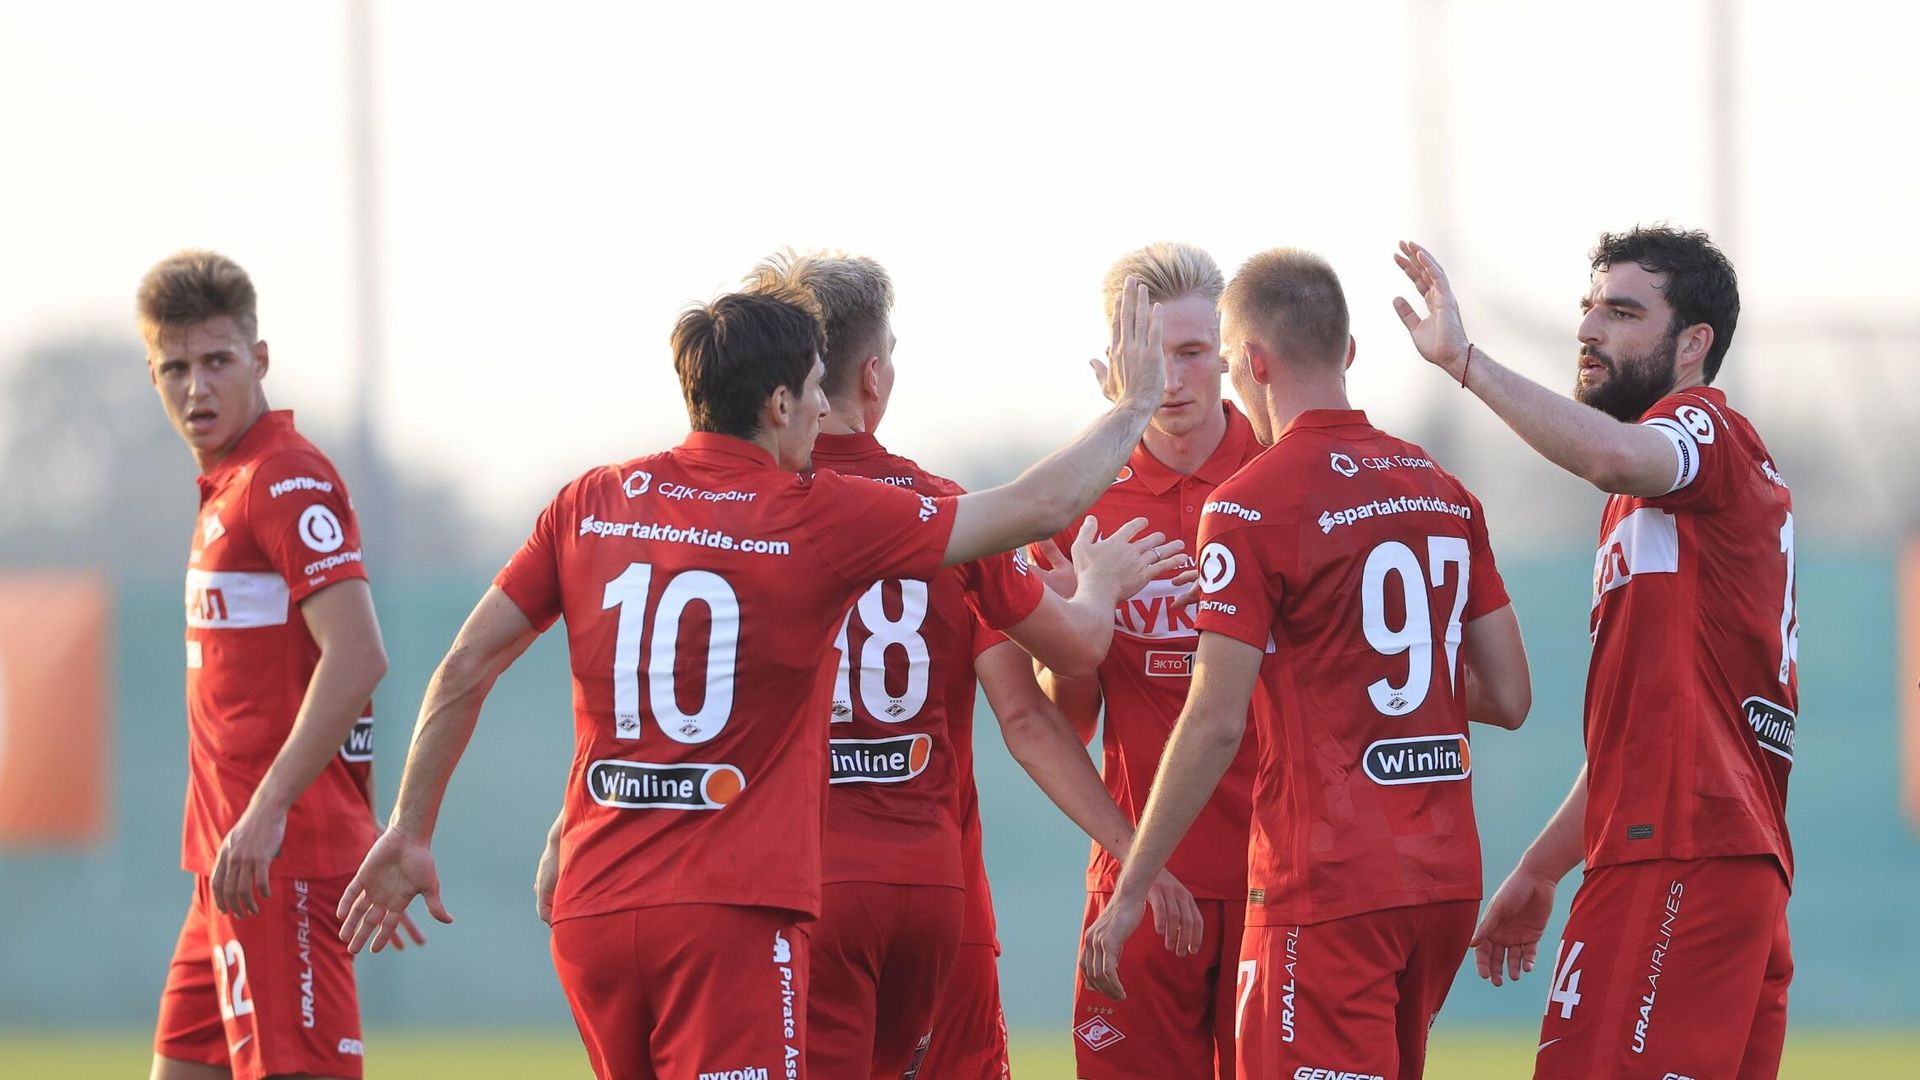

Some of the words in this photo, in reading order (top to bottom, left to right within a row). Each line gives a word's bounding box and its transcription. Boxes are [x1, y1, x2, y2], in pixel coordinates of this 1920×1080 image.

[1362, 456, 1397, 471] СДК
[658, 482, 698, 501] СДК
[591, 520, 790, 555] spartakforkids.com
[1361, 535, 1471, 717] 97
[602, 561, 741, 745] 10
[830, 578, 931, 724] 18
[831, 749, 905, 772] inline
[599, 770, 694, 798] Winline
[779, 966, 796, 1039] Private
